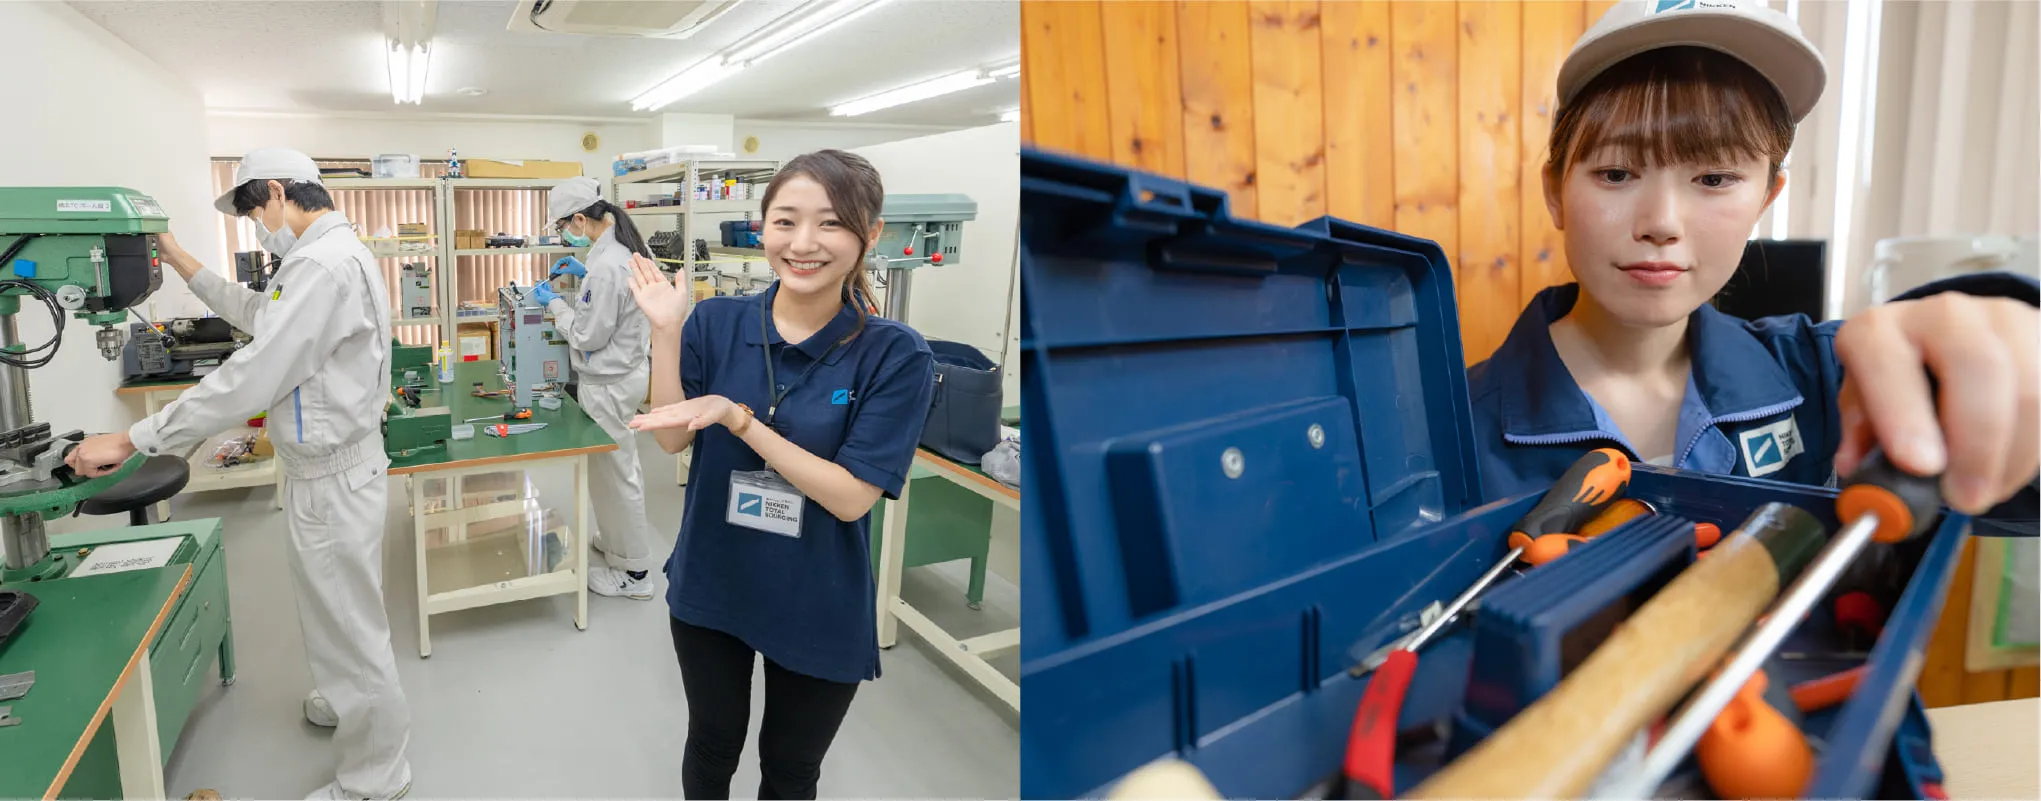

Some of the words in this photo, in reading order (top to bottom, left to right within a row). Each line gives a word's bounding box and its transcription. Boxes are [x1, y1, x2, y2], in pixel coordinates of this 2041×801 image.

[765, 501, 789, 510] NIKKEN
[765, 506, 785, 514] TOTAL
[765, 512, 798, 522] SOURCING
